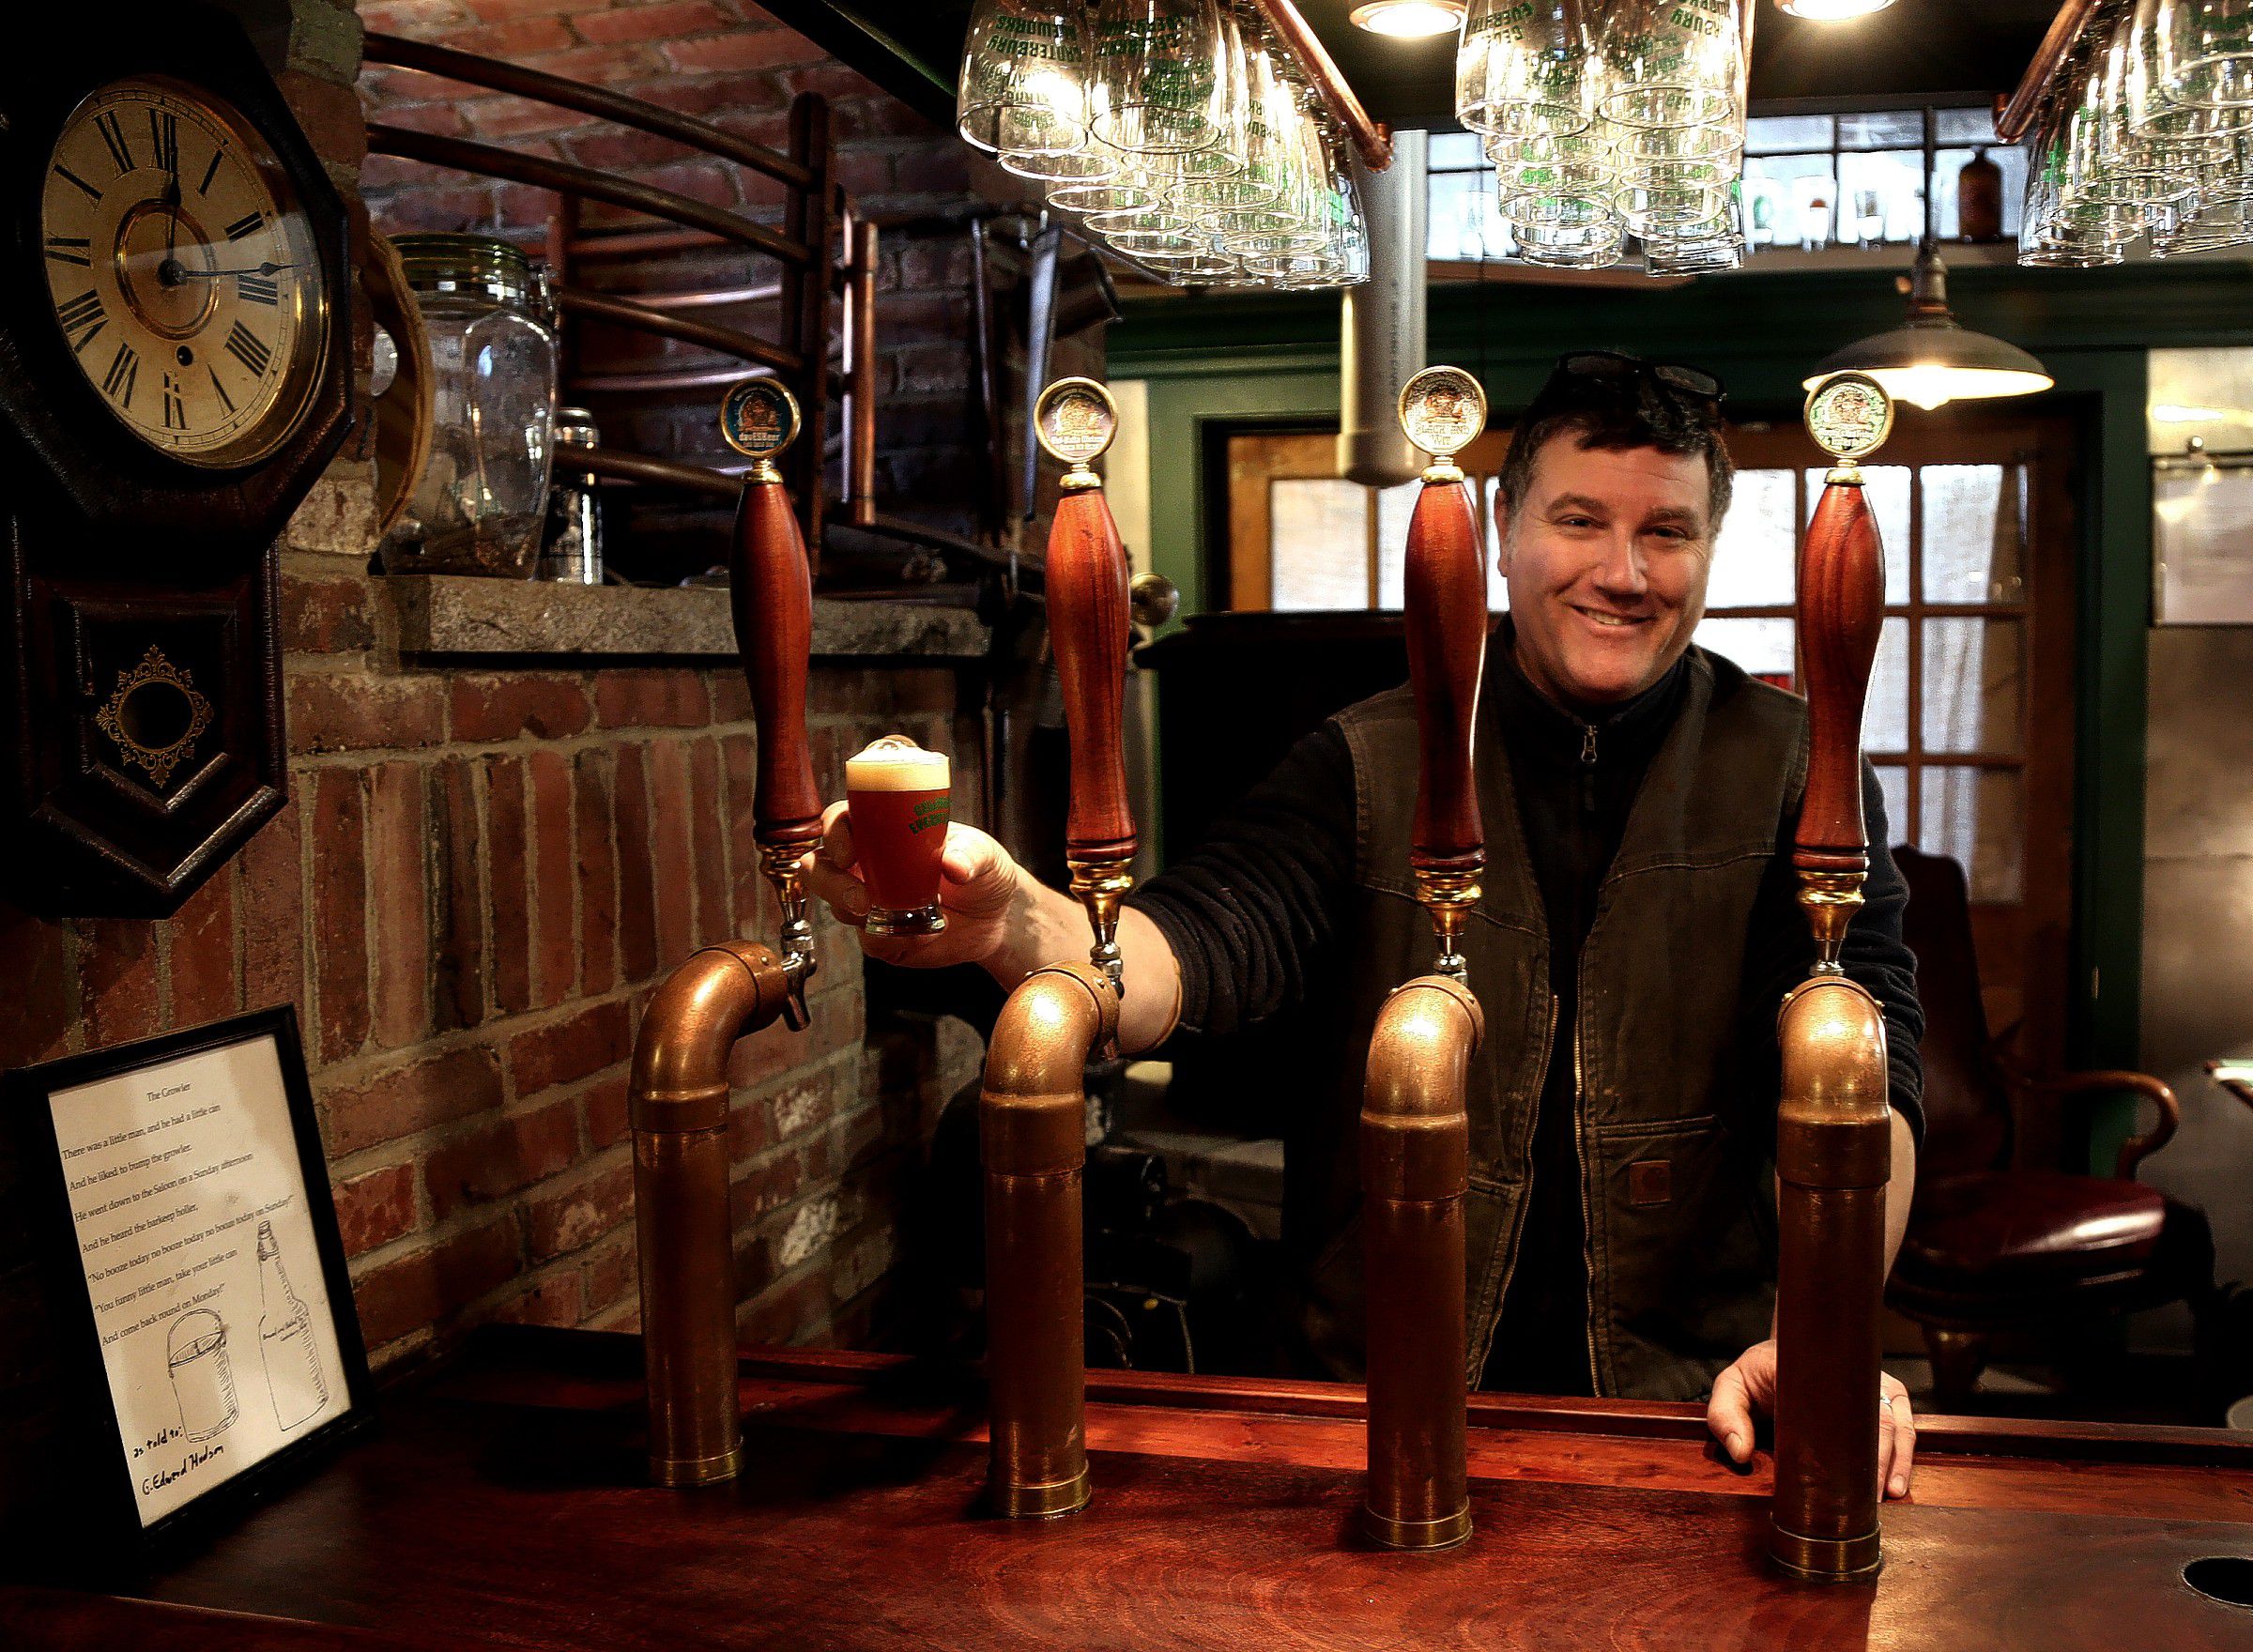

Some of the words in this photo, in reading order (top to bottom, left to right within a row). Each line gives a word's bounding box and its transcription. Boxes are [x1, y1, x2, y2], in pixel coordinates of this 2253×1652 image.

[146, 1090, 161, 1102] The
[161, 1082, 192, 1098] Growler
[62, 1146, 85, 1160] There
[86, 1140, 102, 1153] was
[102, 1140, 109, 1148] a
[108, 1132, 128, 1146] little
[128, 1127, 146, 1140] man,
[147, 1122, 161, 1134] and
[161, 1118, 171, 1129] he
[171, 1113, 185, 1126] had
[186, 1113, 192, 1122] a
[191, 1107, 207, 1120] little
[208, 1105, 222, 1114] can
[69, 1178, 86, 1192] And
[87, 1174, 98, 1185] he
[98, 1167, 119, 1182] liked
[119, 1165, 129, 1174] to
[128, 1158, 151, 1171] bump
[151, 1153, 163, 1164] the
[74, 1210, 87, 1222] He
[88, 1204, 108, 1217] went
[108, 1196, 132, 1211] down
[132, 1192, 142, 1202] to
[141, 1188, 153, 1200] the
[153, 1181, 177, 1195] Saloon
[177, 1176, 187, 1186] on
[193, 1165, 221, 1179] Sunday
[82, 1241, 99, 1253] And
[100, 1237, 111, 1248] he
[110, 1226, 133, 1243] heard
[133, 1222, 147, 1233] the
[146, 1211, 176, 1229] barkeep
[105, 1262, 129, 1277] booze
[129, 1253, 150, 1268] today
[150, 1248, 162, 1260] no
[161, 1239, 184, 1255] booze
[183, 1231, 205, 1246] today
[206, 1228, 215, 1238] no
[214, 1218, 236, 1233] booze
[235, 1210, 254, 1224] today
[255, 1207, 265, 1216] on
[115, 1291, 137, 1306] funny
[138, 1283, 157, 1296] little
[156, 1277, 175, 1289] man,
[176, 1269, 192, 1280] take
[192, 1262, 208, 1277] your
[207, 1254, 226, 1266] little
[225, 1249, 238, 1260] can
[101, 1331, 119, 1347] And
[119, 1323, 140, 1337] come
[140, 1314, 159, 1328] back
[159, 1303, 181, 1320] round
[181, 1300, 192, 1310] on
[133, 1447, 145, 1459] as
[146, 1428, 168, 1450] told
